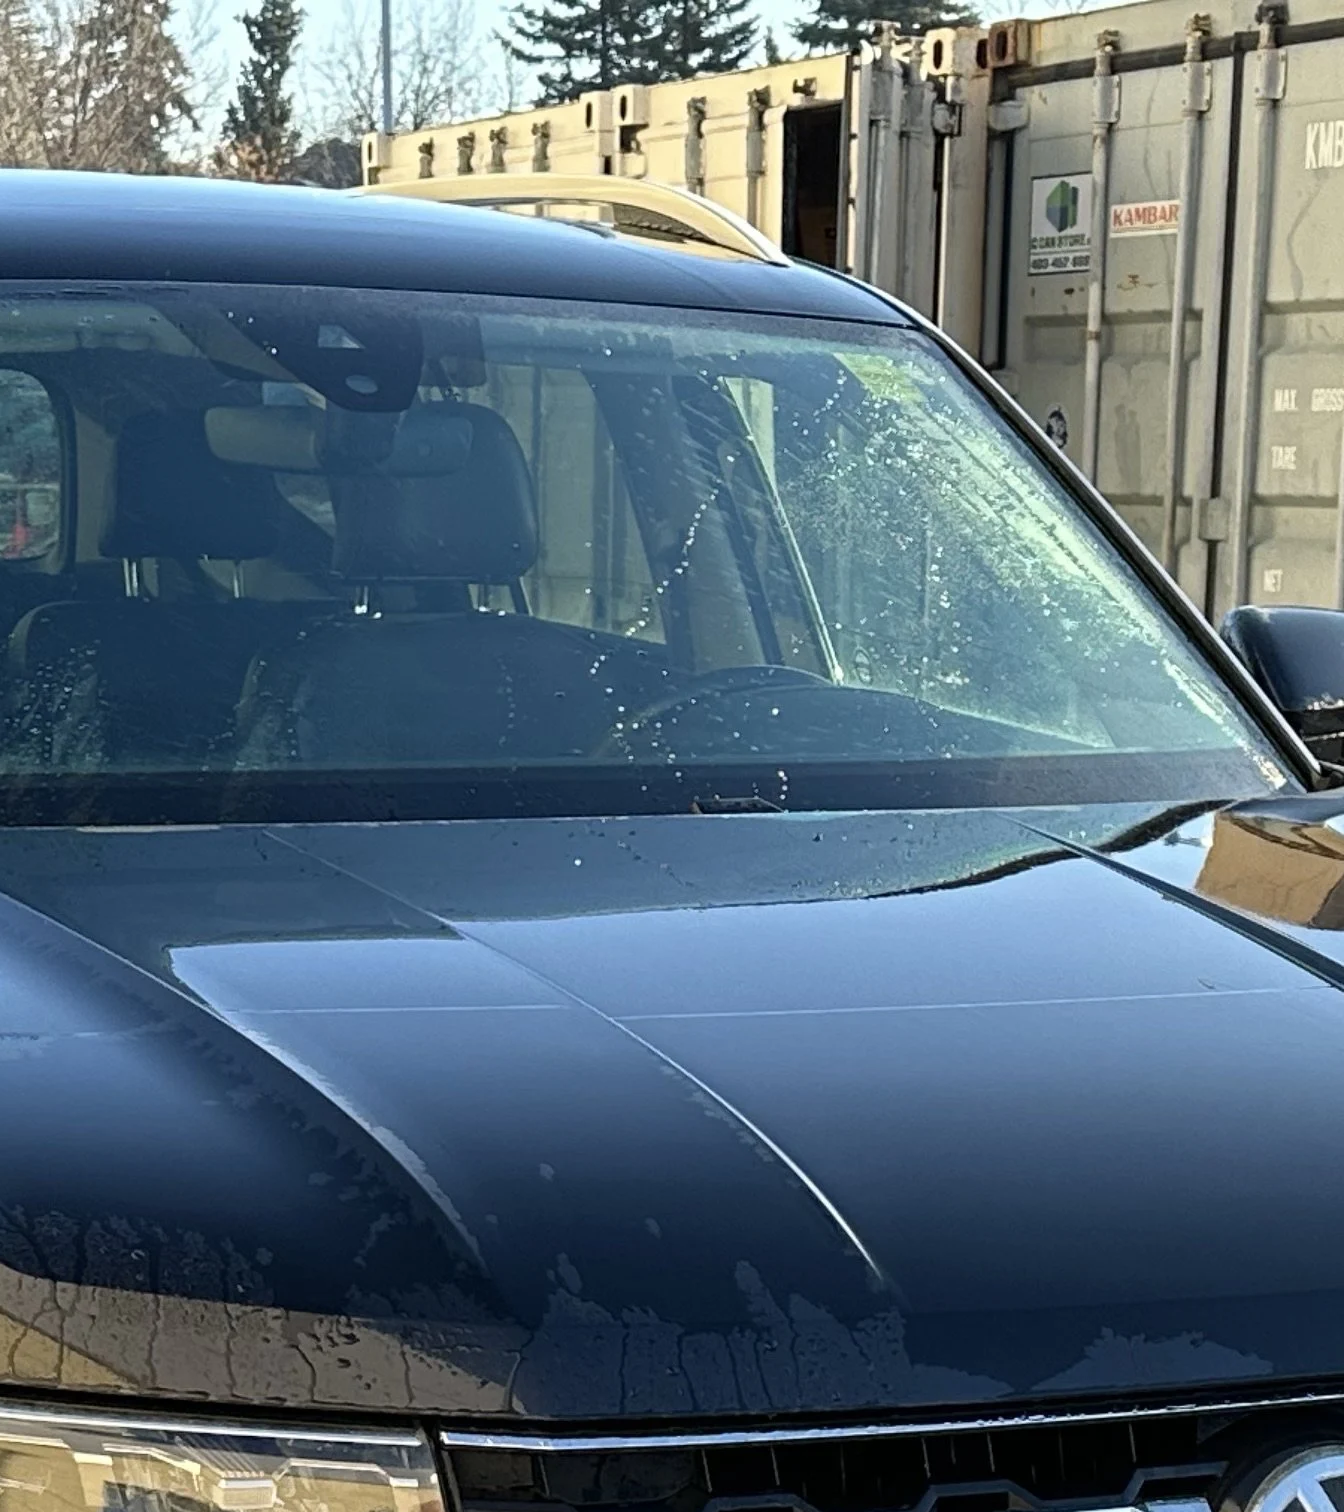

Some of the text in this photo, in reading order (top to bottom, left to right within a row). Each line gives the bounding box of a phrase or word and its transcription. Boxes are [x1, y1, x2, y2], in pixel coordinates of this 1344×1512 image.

[1112, 203, 1180, 227] KAMBAR
[1271, 445, 1297, 470] TARE
[1263, 569, 1284, 593] NET
